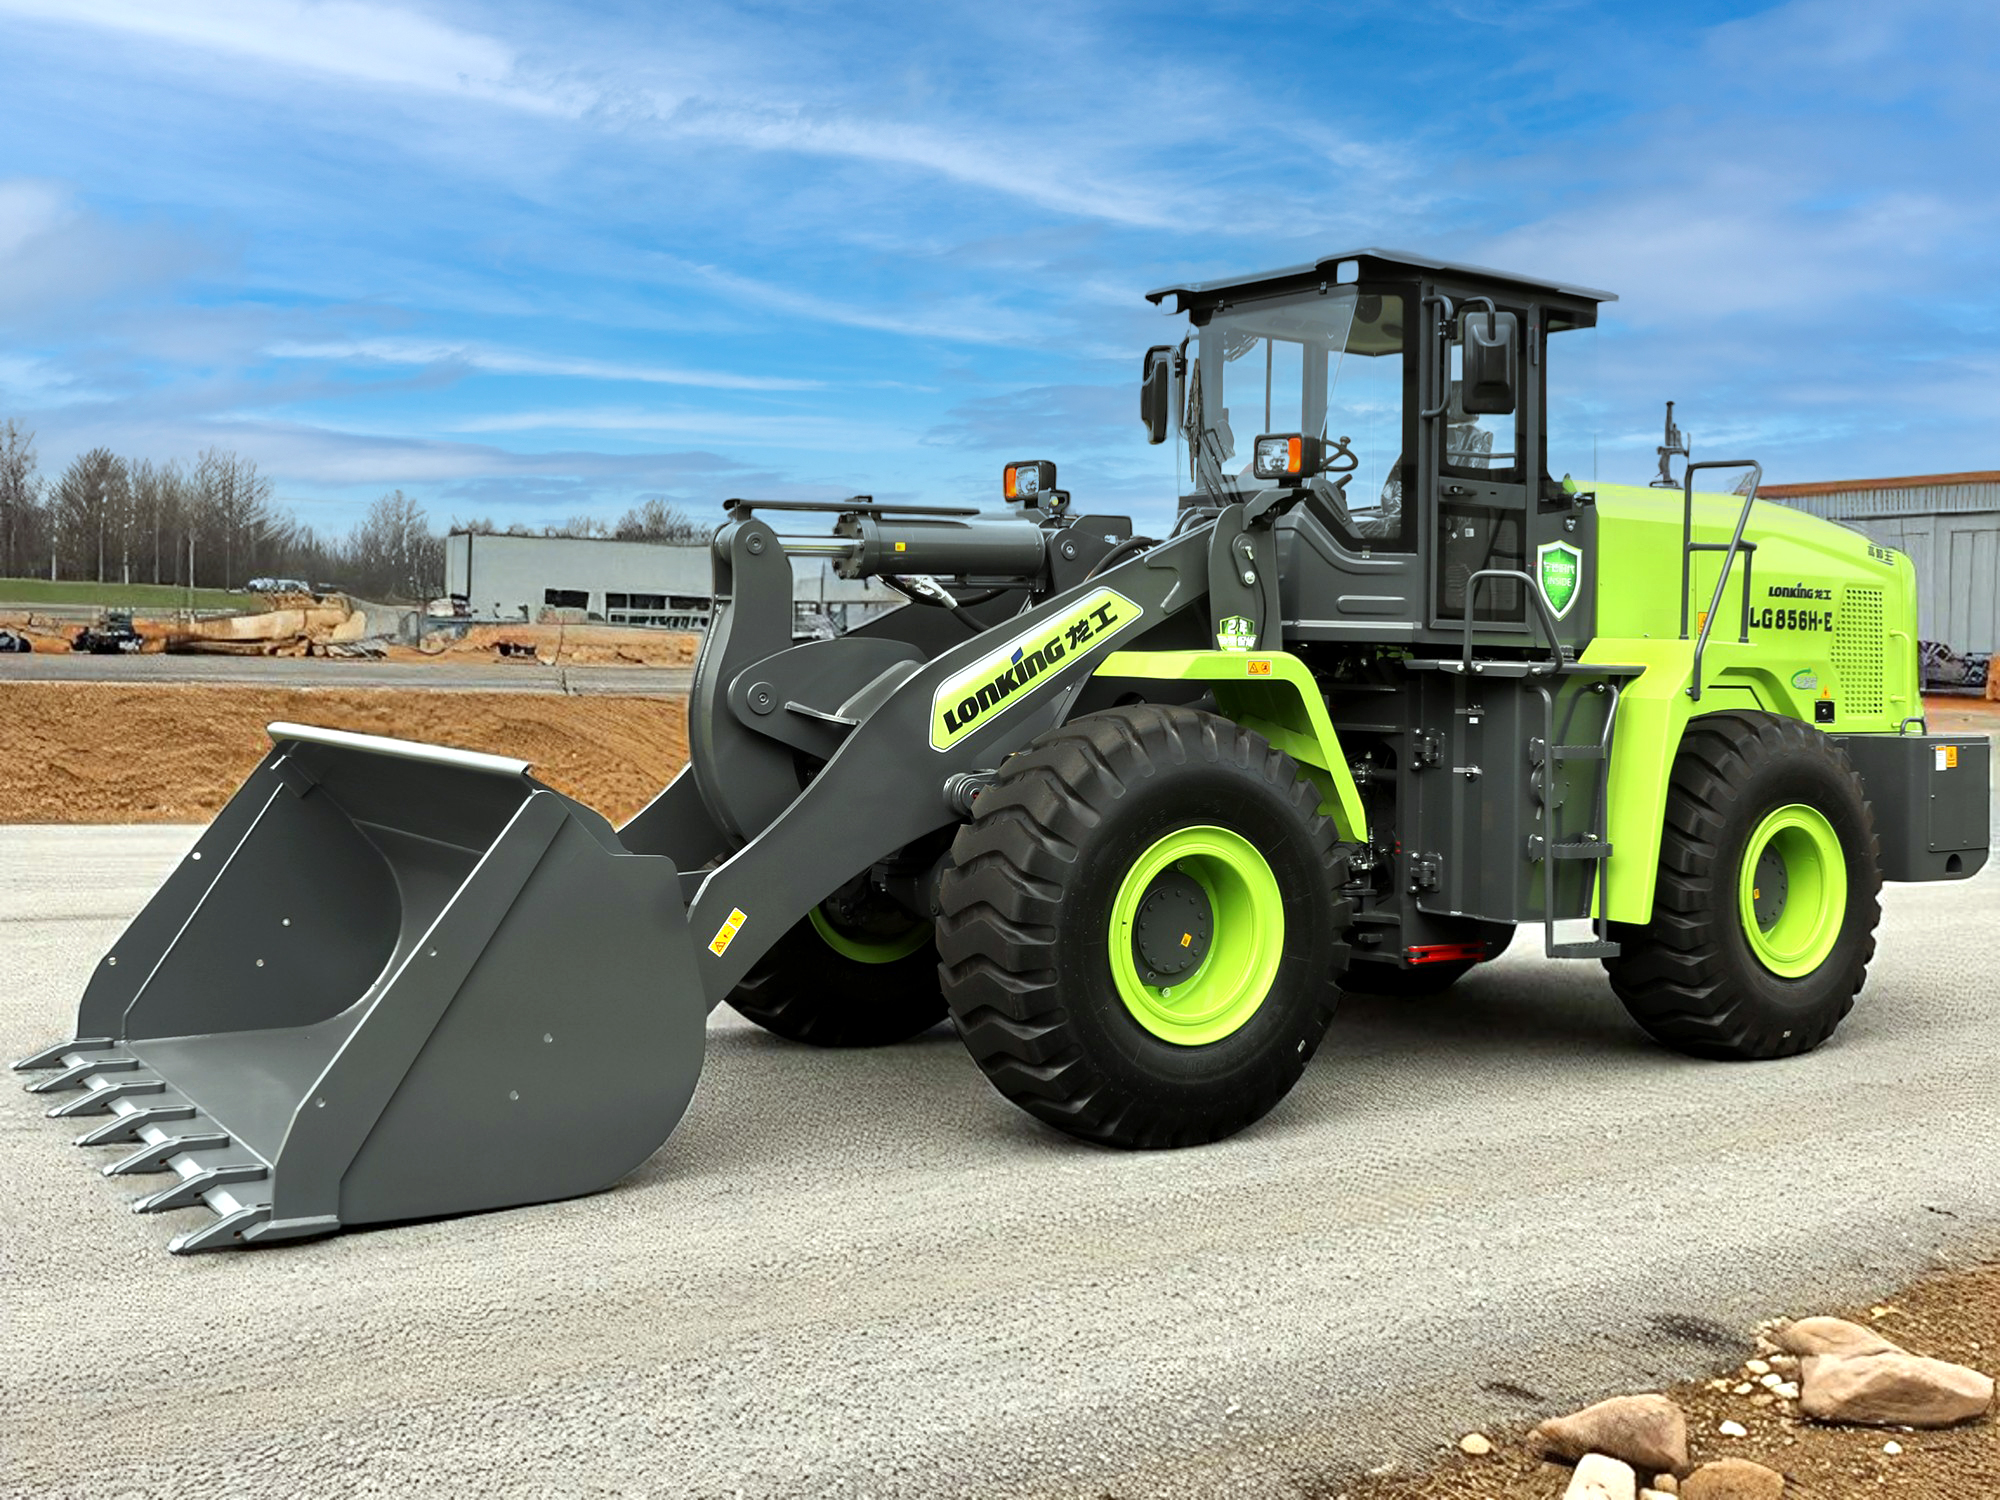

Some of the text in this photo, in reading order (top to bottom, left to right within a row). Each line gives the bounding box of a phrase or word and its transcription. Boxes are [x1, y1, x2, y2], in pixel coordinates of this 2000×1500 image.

[1547, 576, 1572, 587] INSIDE
[1814, 589, 1832, 600] 龙工
[1065, 601, 1118, 650] 龙工
[1749, 607, 1833, 632] LG856H-E
